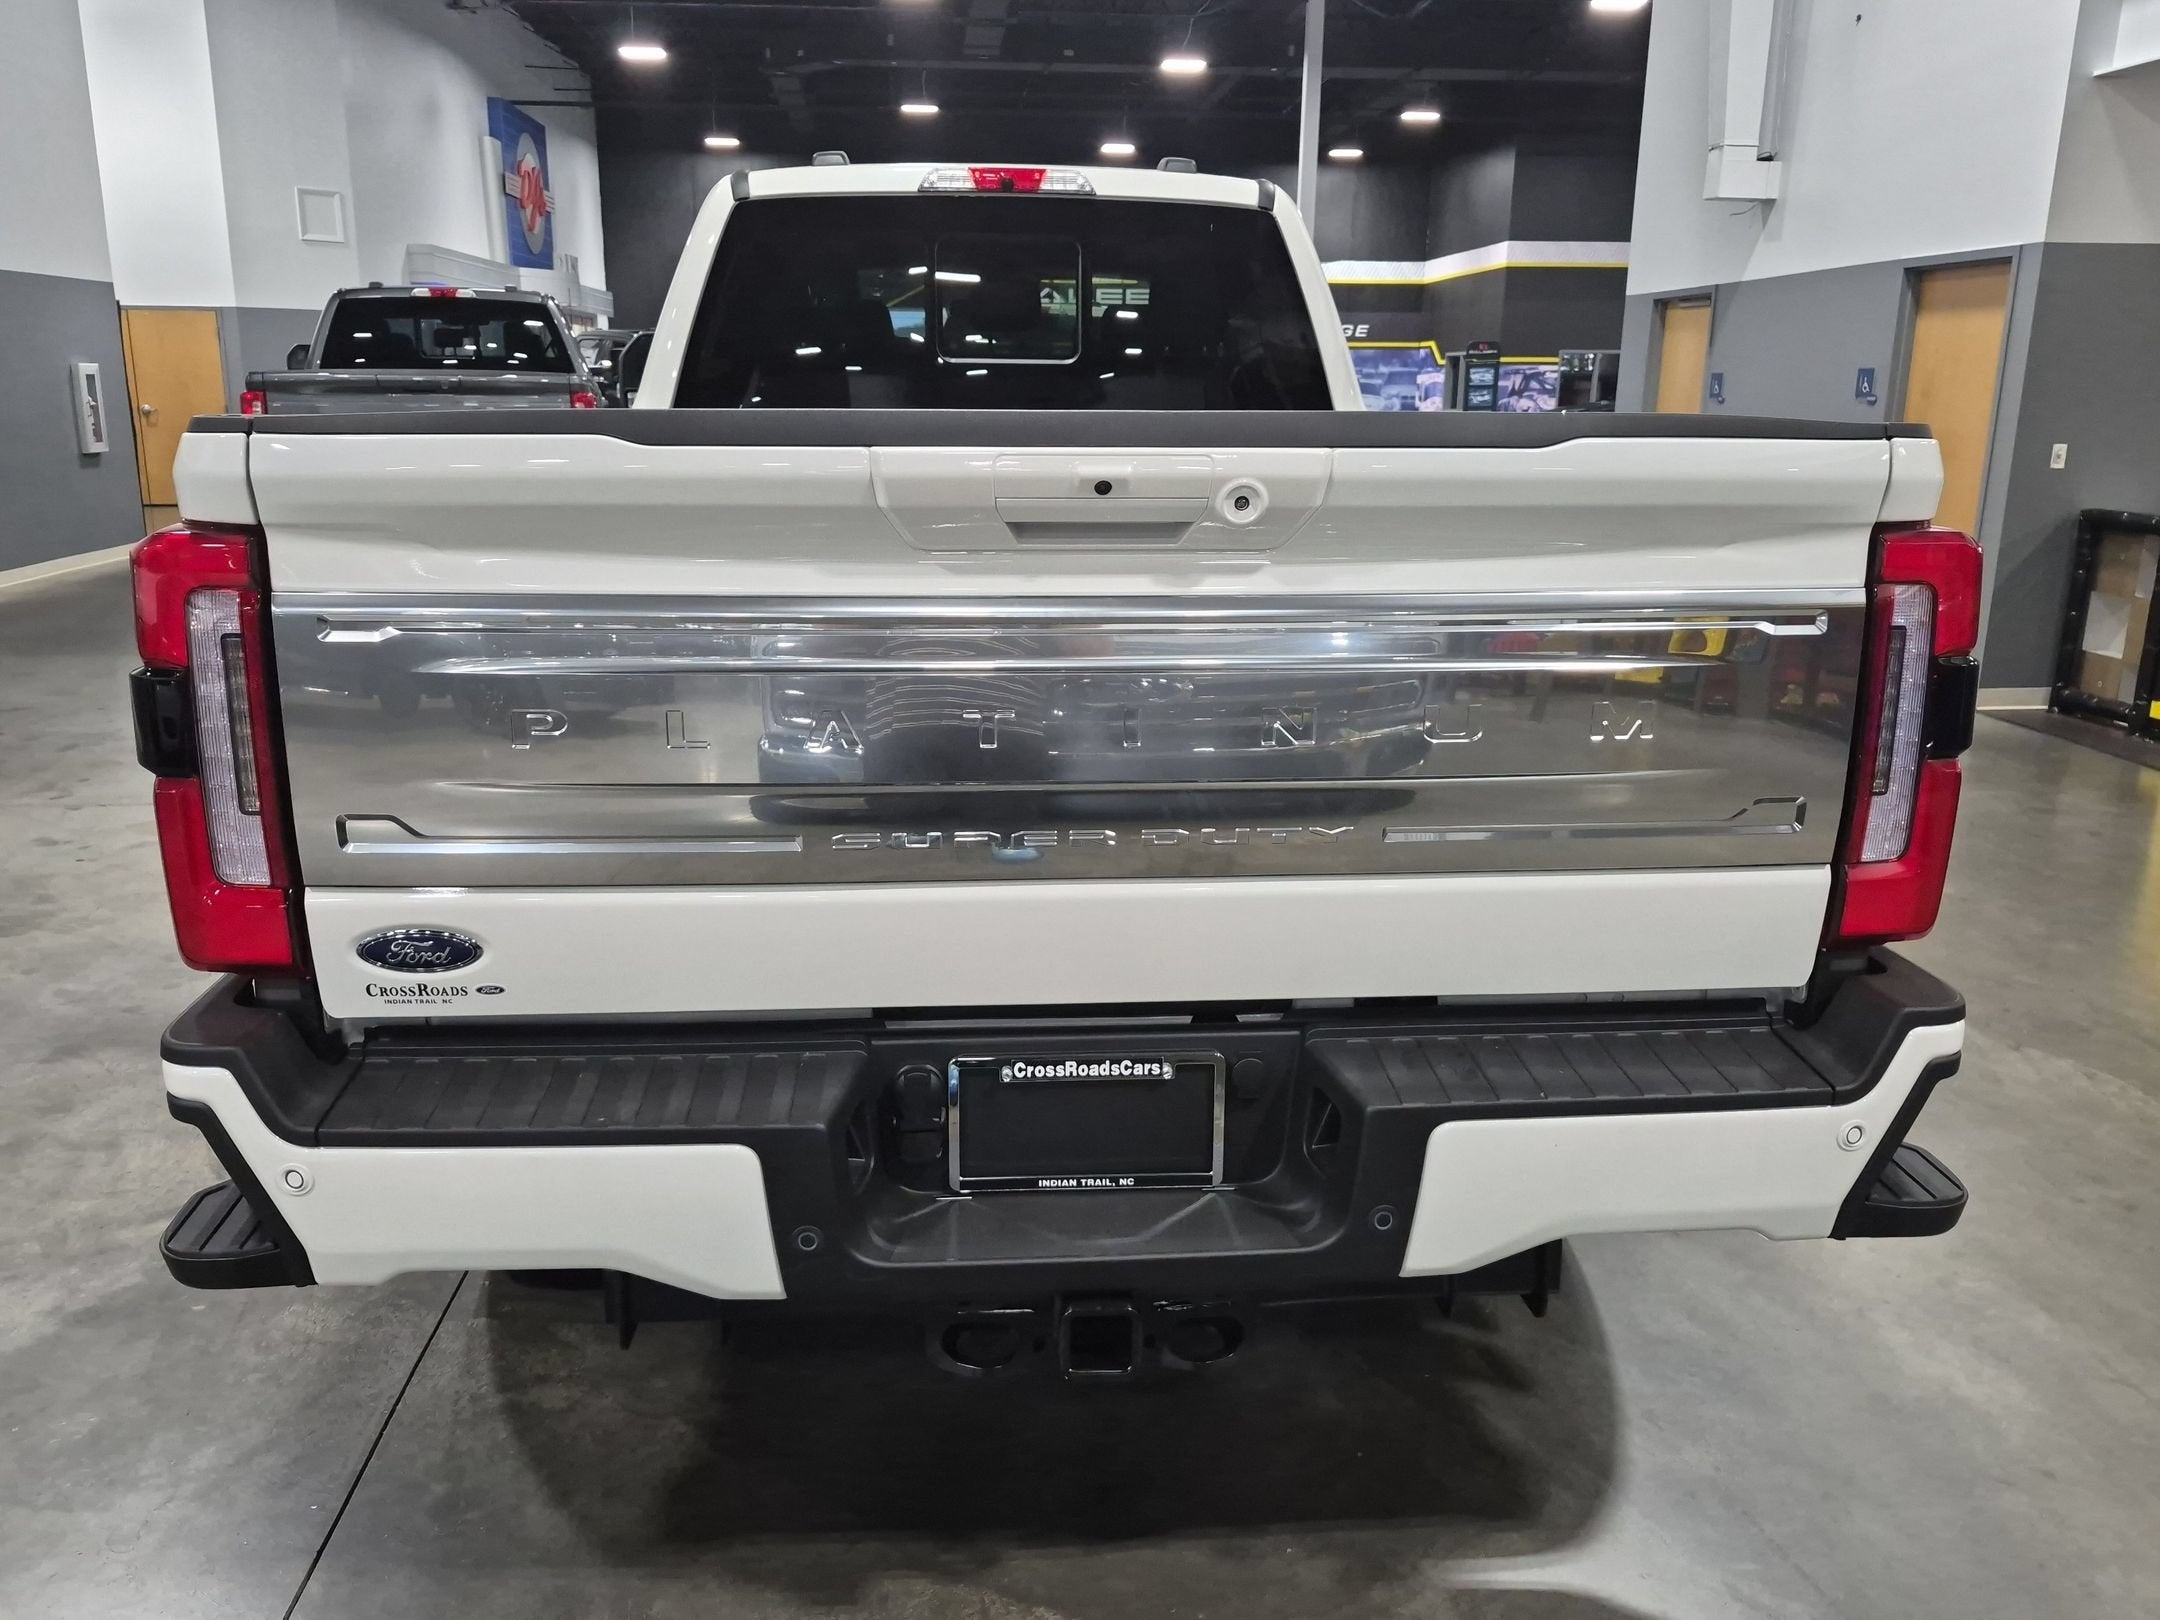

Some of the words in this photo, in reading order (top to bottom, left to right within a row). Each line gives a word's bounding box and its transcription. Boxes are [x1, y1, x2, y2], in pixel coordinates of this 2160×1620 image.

[511, 701, 1657, 750] PLATINUM
[831, 829, 1116, 850] SUPER
[1141, 826, 1355, 846] DUTY
[386, 939, 452, 965] Ford
[1014, 1060, 1161, 1080] CrossRoadsCars
[1038, 1178, 1078, 1188] INDIAN
[1080, 1178, 1117, 1188] TRAIL,
[1119, 1178, 1136, 1187] NC
